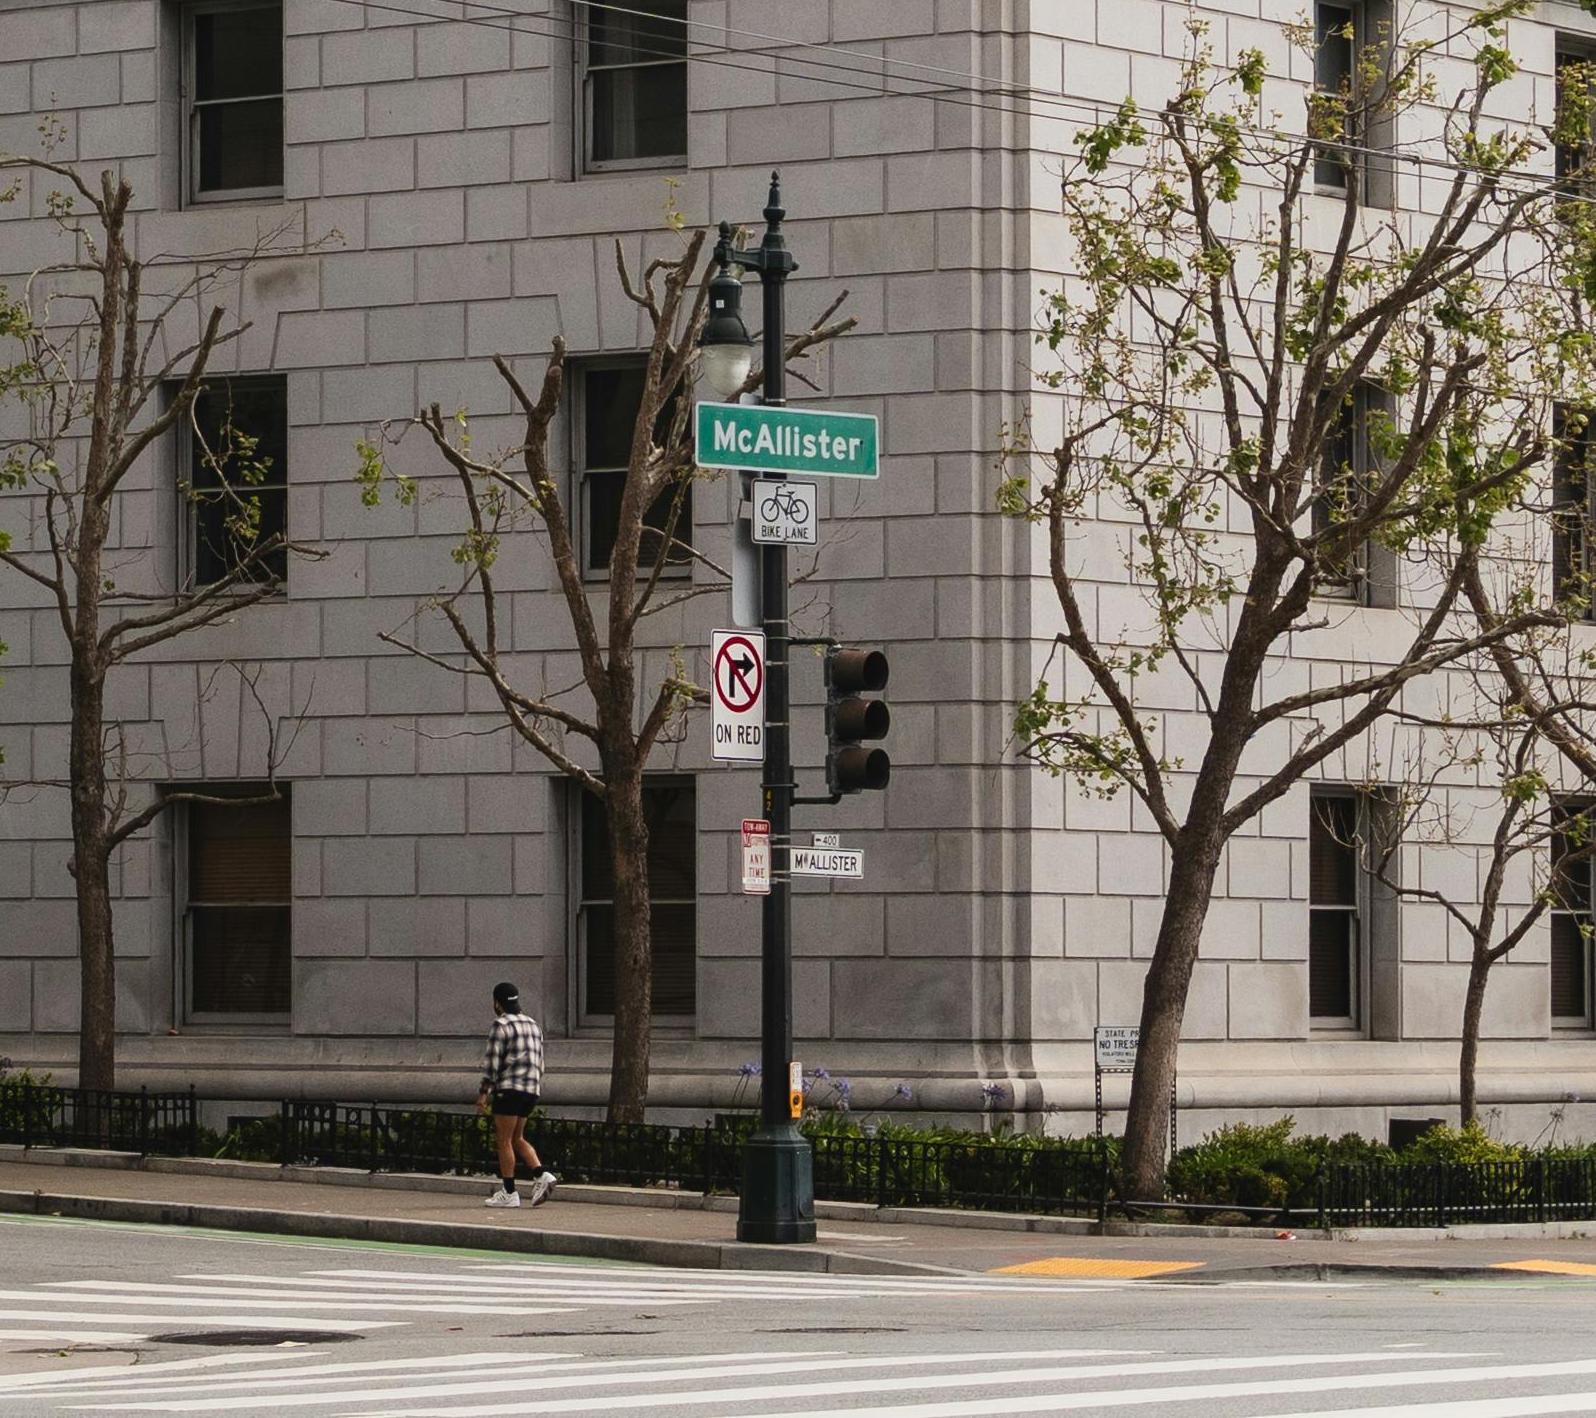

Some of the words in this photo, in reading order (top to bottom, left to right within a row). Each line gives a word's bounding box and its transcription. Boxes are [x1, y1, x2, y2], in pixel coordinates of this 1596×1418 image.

[714, 420, 860, 461] McAllister
[761, 525, 781, 539] BIKE
[785, 526, 809, 539] LANE
[716, 723, 732, 744] ON
[738, 725, 761, 745] RED
[823, 835, 837, 846] 400
[750, 854, 763, 865] ANY
[749, 867, 765, 878] TIME
[1105, 1029, 1125, 1038] STATE
[1099, 1040, 1111, 1049] NO
